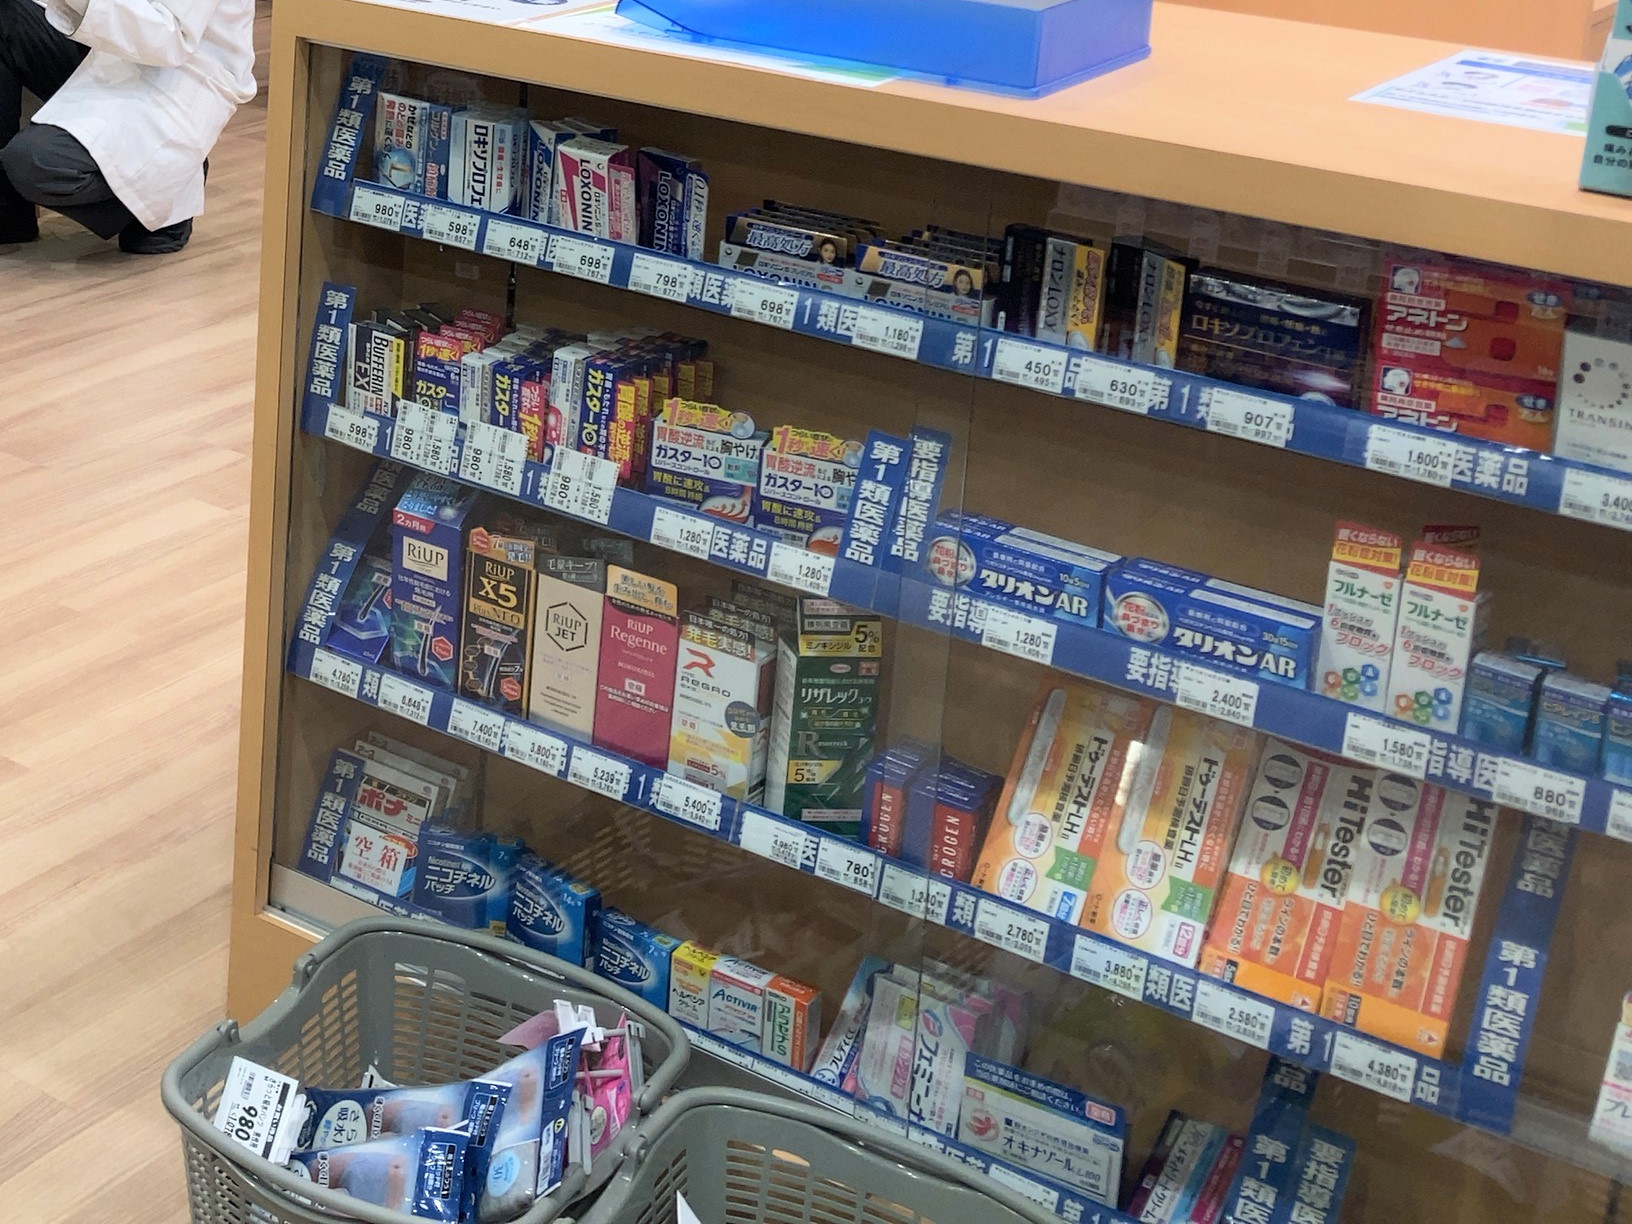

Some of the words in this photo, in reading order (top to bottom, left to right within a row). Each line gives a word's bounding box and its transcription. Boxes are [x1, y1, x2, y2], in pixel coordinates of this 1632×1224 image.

[323, 76, 376, 182] 第1類医薬品
[579, 158, 592, 232] LOXONIN
[375, 203, 394, 217] 980
[448, 221, 468, 235] 598
[509, 237, 530, 251] 648
[747, 230, 812, 257] 最高処方
[579, 255, 601, 270] 698
[879, 260, 945, 288] 最高処方
[655, 273, 677, 288] 798
[760, 300, 784, 315] 698
[1385, 304, 1468, 332] アネトン
[310, 290, 349, 398] 第1類医薬品
[354, 361, 371, 392] EX
[370, 335, 389, 396] BUFFERIN
[1024, 359, 1052, 376] 450
[415, 380, 456, 398] ガスター
[494, 372, 512, 426] ガスター
[1109, 379, 1138, 396] 630
[348, 423, 367, 439] 598
[1244, 412, 1274, 428] 907
[1377, 406, 1458, 434] アネトン
[400, 427, 415, 453] 980
[656, 427, 705, 449] 胃酸逆流
[469, 447, 484, 474] 980
[766, 453, 817, 476] 胃酸逆流
[557, 475, 572, 501] 980
[845, 440, 903, 565] 第1類医薬品
[713, 527, 767, 570] 医薬品
[1338, 528, 1398, 547] 眠くならない
[407, 542, 445, 565] RiUP
[1413, 549, 1478, 569] 眠くならない
[485, 560, 515, 579] RiUP
[299, 542, 357, 645] 第1類医薬品
[478, 576, 518, 608] X5
[980, 568, 1089, 617] タリオンAR
[1333, 578, 1394, 608] フルナーゼ
[552, 613, 582, 631] RiUP
[627, 618, 654, 635] RiUP
[1407, 600, 1468, 630] フルナーゼ
[554, 627, 577, 642] JET
[610, 625, 668, 656] Regenne
[805, 641, 852, 652] ミノキシジル
[855, 623, 879, 644] 5%
[1335, 632, 1392, 656] ブロック
[1173, 626, 1297, 680] タリオンAR
[1407, 653, 1464, 679] ブロック
[1533, 786, 1566, 808] 880
[308, 758, 358, 864] 第1類医薬品
[1320, 774, 1371, 906] HiTester
[355, 836, 401, 872] 空箱
[1442, 798, 1497, 931] HiTester
[424, 864, 495, 890] ニコチネル
[845, 860, 870, 878] 780
[424, 880, 456, 894] パッチ
[512, 891, 567, 933] ニコチネル
[512, 907, 536, 927] パッチ
[598, 944, 652, 982] ニコチネル
[598, 957, 623, 976] パッチ
[1473, 940, 1541, 1088] 第1類医薬品
[234, 1106, 258, 1142] 980
[1003, 1135, 1075, 1172] オキナゾール
